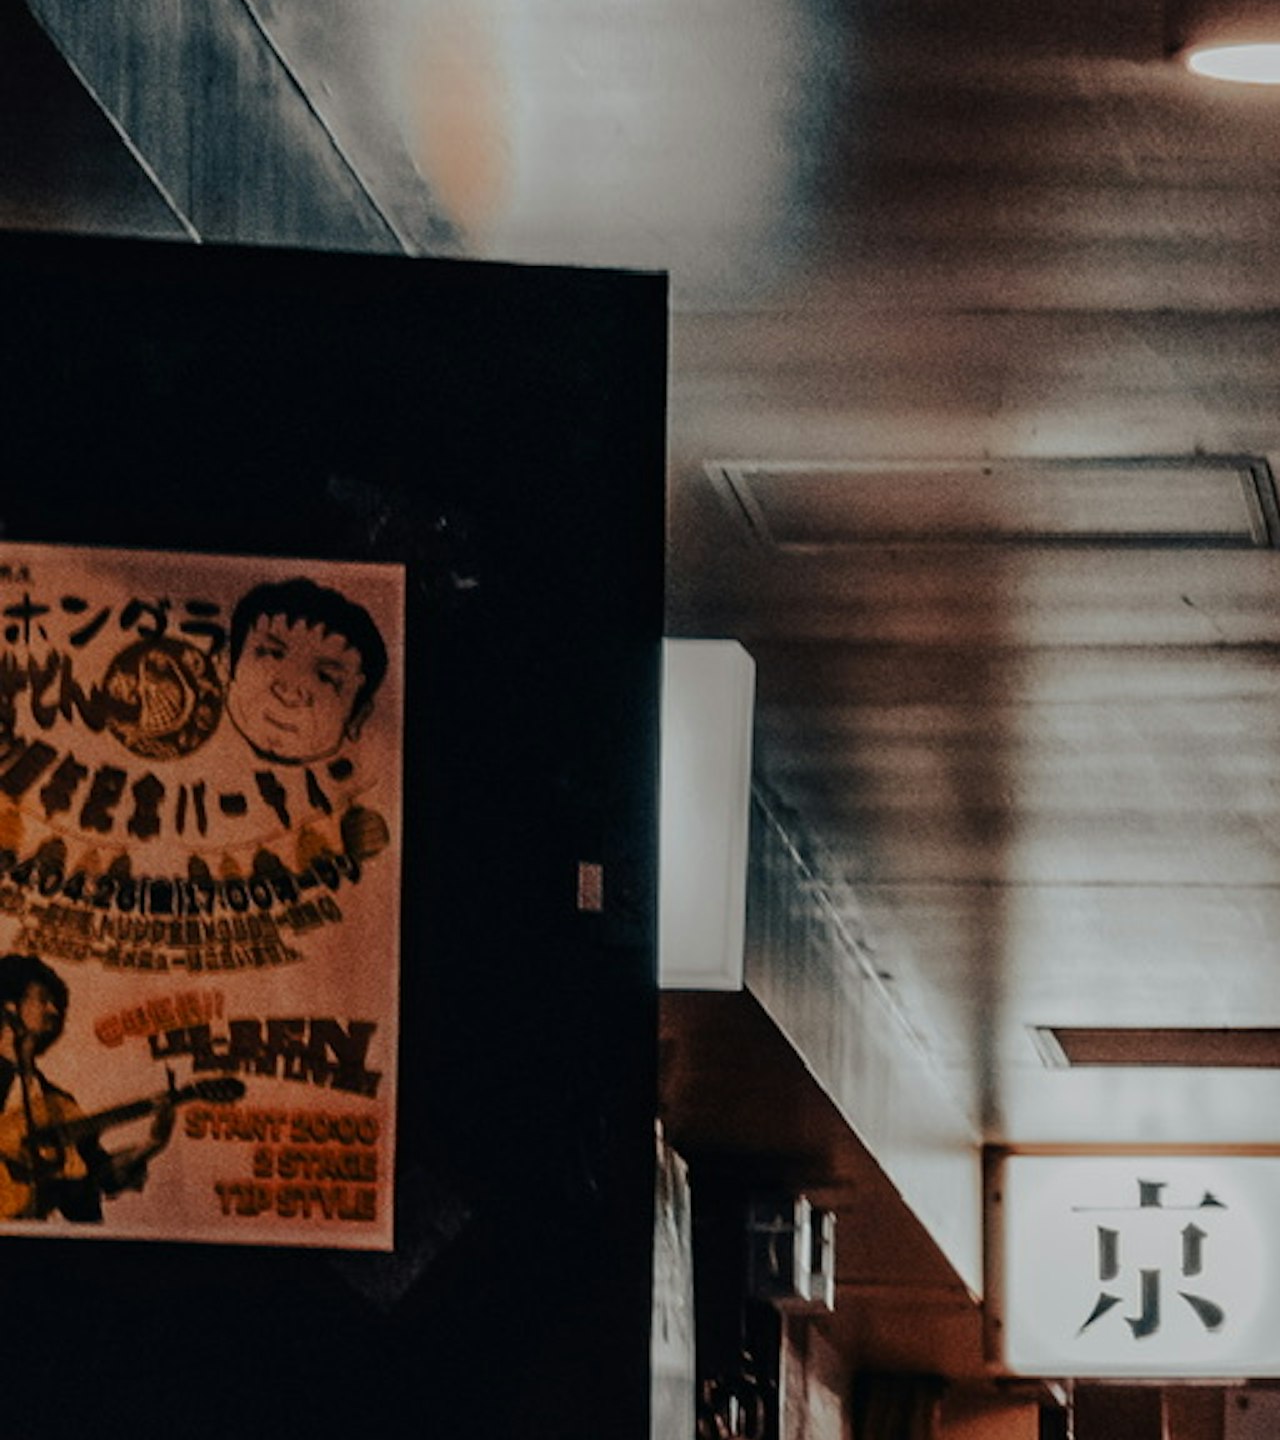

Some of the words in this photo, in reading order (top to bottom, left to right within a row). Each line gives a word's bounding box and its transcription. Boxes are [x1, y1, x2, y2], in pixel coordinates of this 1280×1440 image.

[185, 1107, 287, 1143] START
[291, 1111, 379, 1146] 20:00
[277, 1147, 377, 1183] STAGE
[276, 1182, 376, 1222] STYLE
[1072, 1177, 1229, 1341] 京
